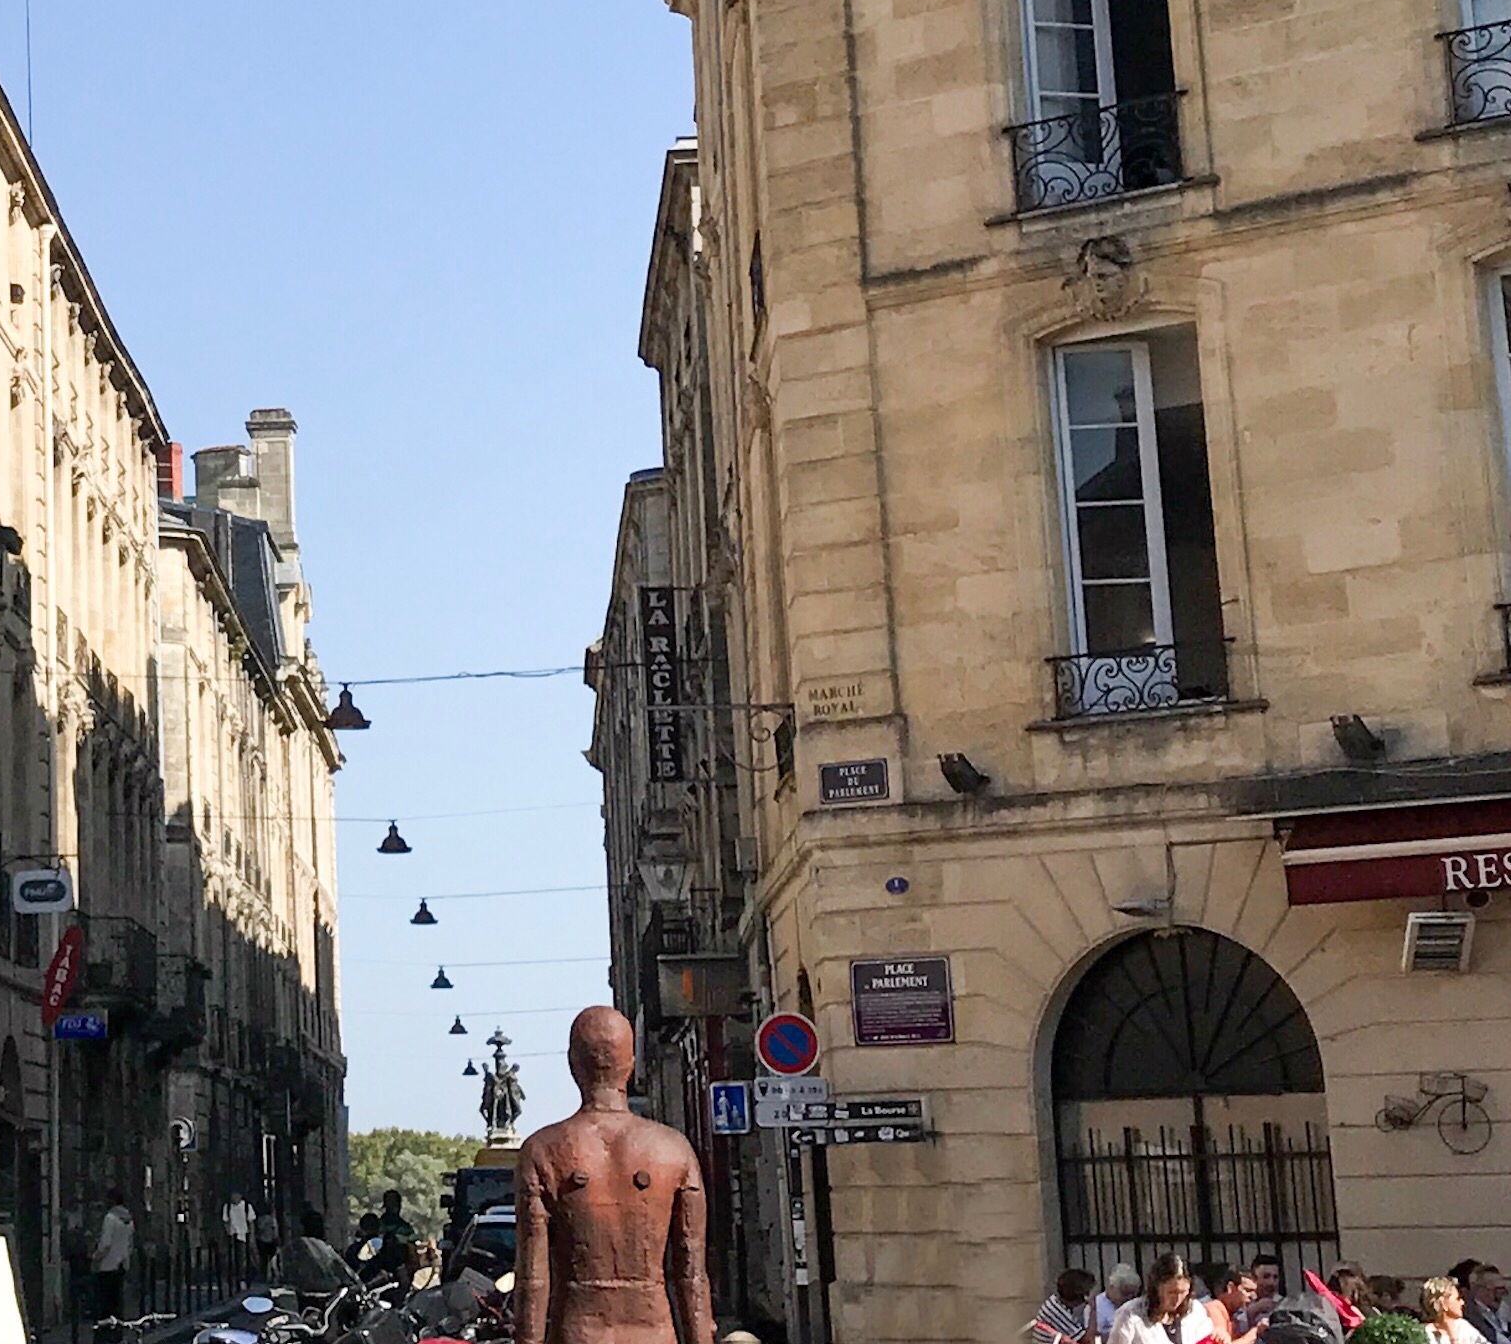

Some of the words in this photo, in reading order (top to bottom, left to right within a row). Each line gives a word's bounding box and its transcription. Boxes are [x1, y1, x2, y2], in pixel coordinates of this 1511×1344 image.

[647, 591, 669, 625] LA
[649, 636, 677, 778] RACLETTE
[839, 765, 867, 777] PLACE
[828, 784, 880, 799] PARLEMENT
[50, 944, 73, 1007] TABAC
[884, 963, 915, 976] PLACE
[871, 976, 928, 990] PARLEMENT
[861, 1106, 874, 1116] La
[874, 1105, 907, 1115] Bourse
